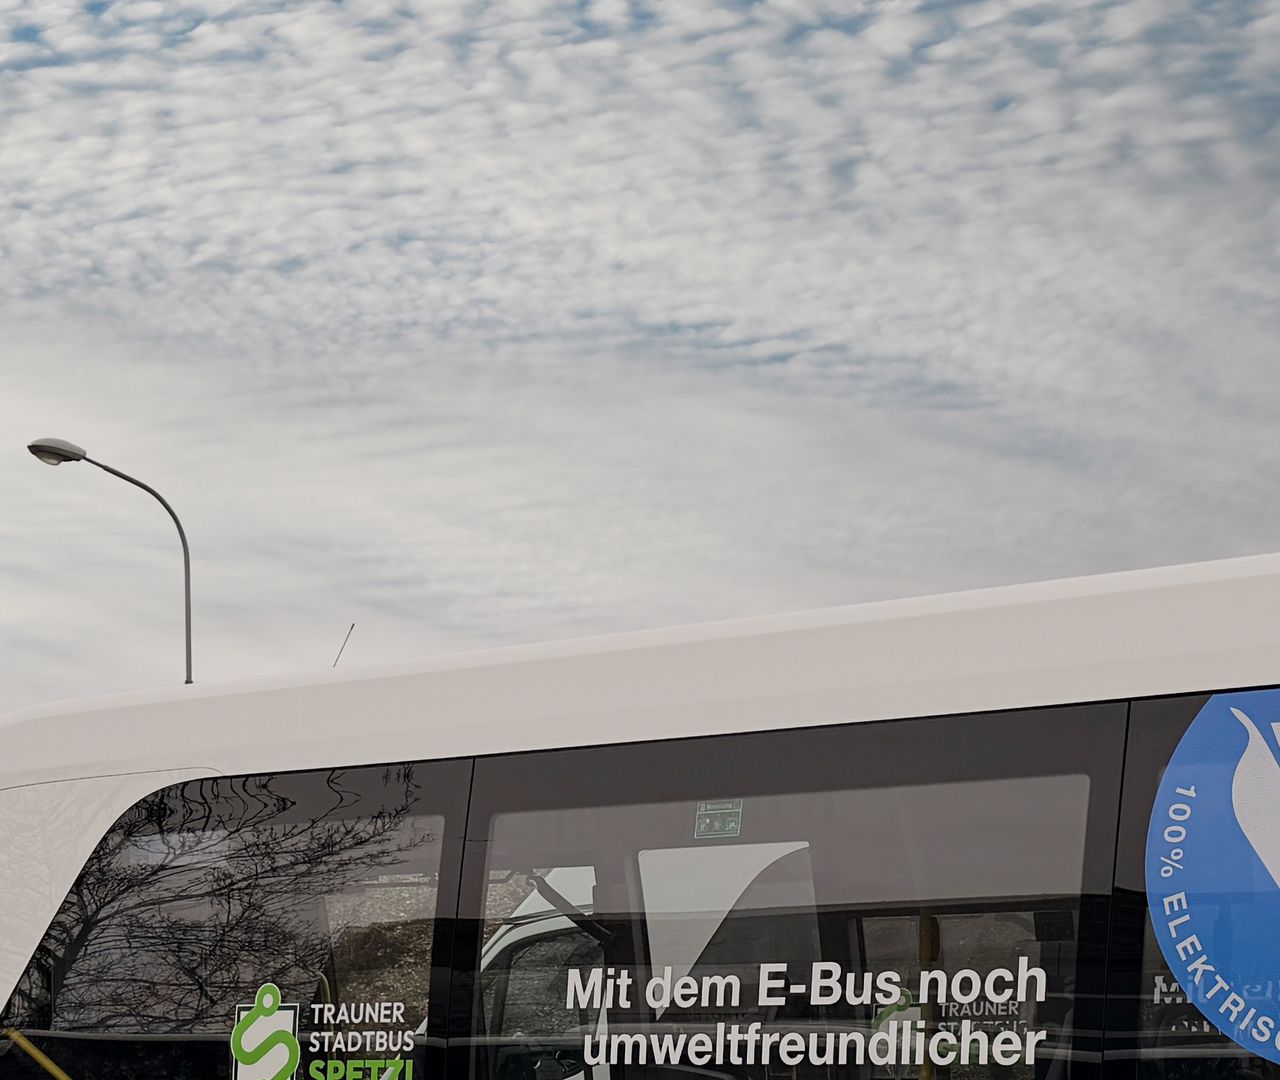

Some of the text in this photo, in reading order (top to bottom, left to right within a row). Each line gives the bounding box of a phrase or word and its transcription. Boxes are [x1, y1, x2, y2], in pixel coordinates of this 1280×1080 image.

[1160, 785, 1198, 879] 100%
[565, 956, 1047, 1010] Mit dem E-Bus noch
[310, 1001, 406, 1024] TRAUNER
[308, 1030, 416, 1053] STADTBUS
[583, 1019, 1048, 1066] umweltfreundlicher
